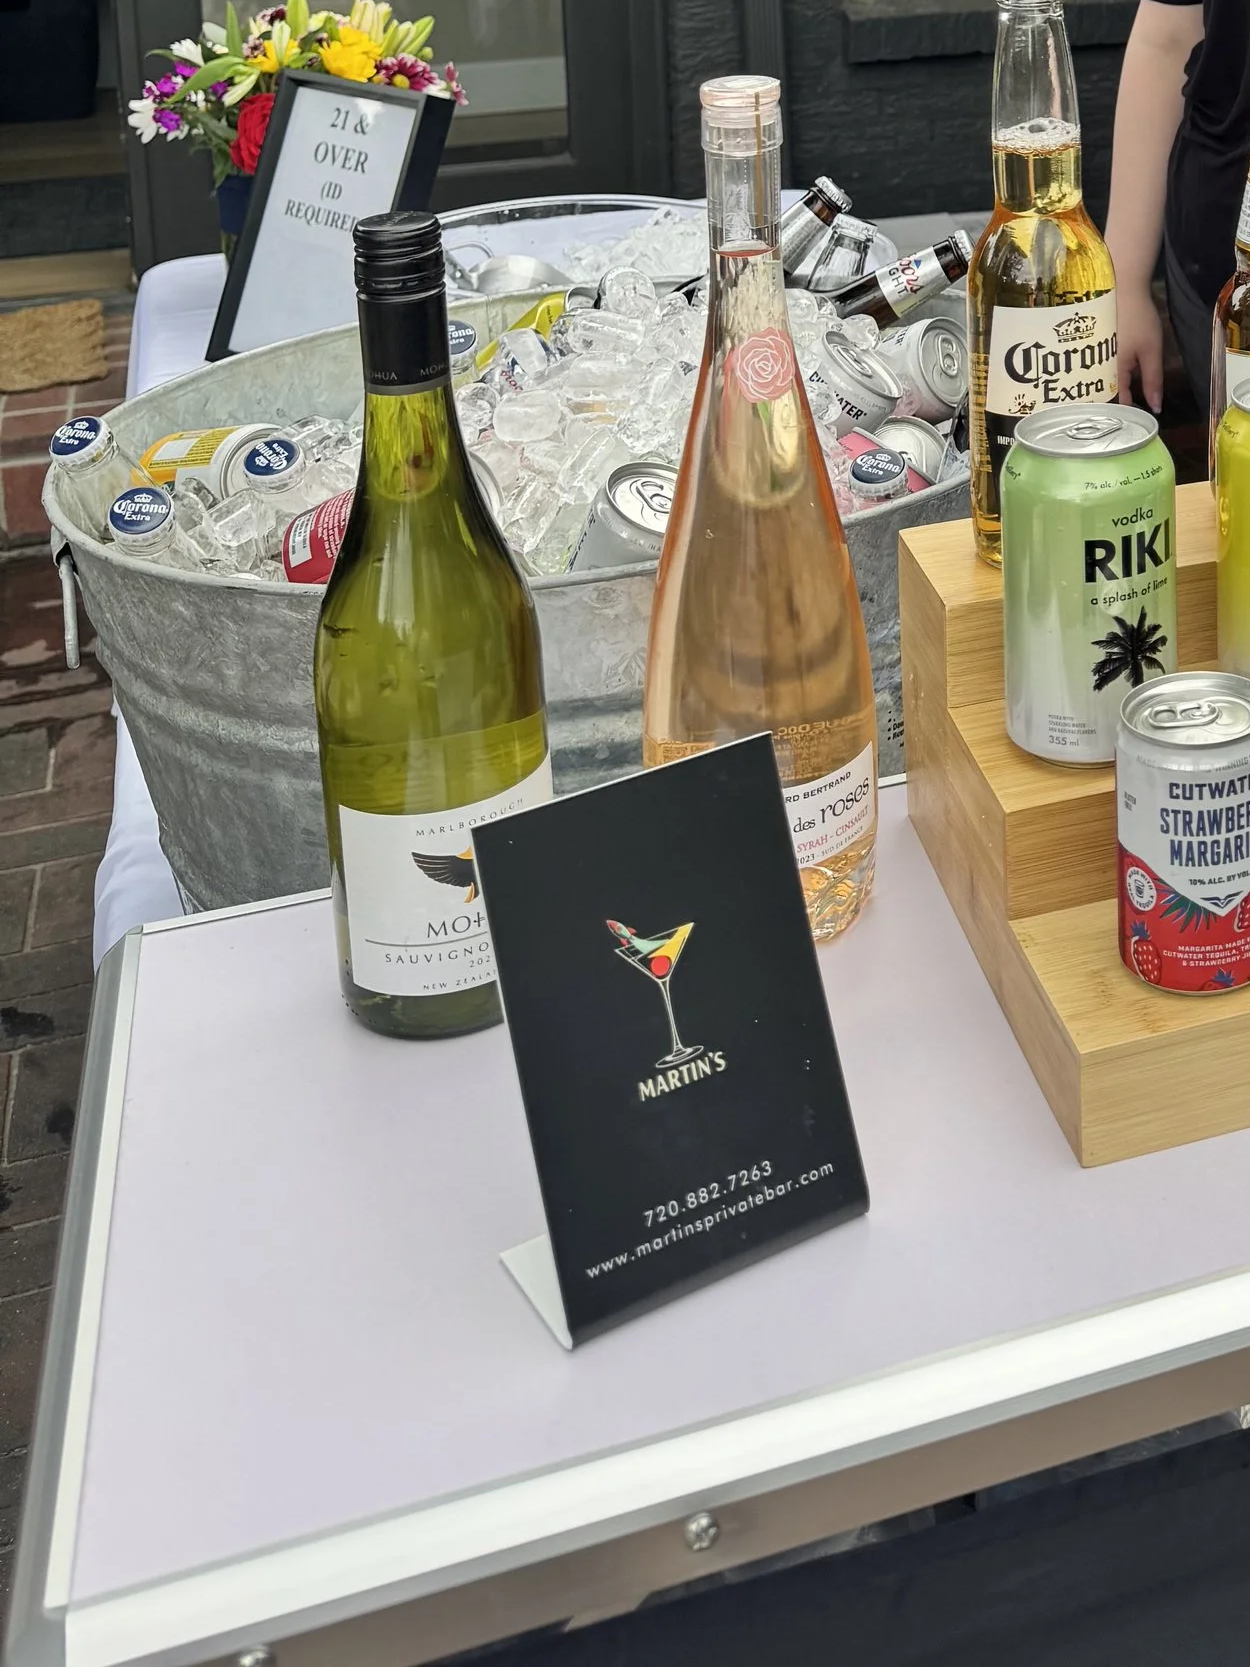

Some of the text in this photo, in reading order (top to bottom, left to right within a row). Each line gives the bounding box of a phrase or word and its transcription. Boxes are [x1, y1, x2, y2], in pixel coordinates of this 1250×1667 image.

[330, 107, 371, 135] 21 &
[314, 141, 369, 174] OVER
[320, 181, 342, 200] (ID
[1004, 331, 1118, 388] Corona
[809, 371, 865, 420] CATER
[1043, 377, 1105, 404] Extra
[55, 424, 96, 442] Corona
[856, 455, 901, 473] Corona
[113, 496, 168, 514] Corona
[124, 511, 151, 522] Extra
[1112, 507, 1154, 528] vodka
[1084, 517, 1170, 583] RIKI
[1090, 577, 1168, 607] a splash of lime
[803, 771, 852, 800] BERTRAND
[416, 798, 524, 836] MARLBOROUGH
[793, 777, 870, 833] des roses
[796, 835, 828, 854] SYRAH
[835, 805, 869, 837] CINSAULT
[1189, 878, 1206, 886] 10%
[1207, 876, 1225, 885] ALC.
[1226, 874, 1236, 883] BY
[385, 941, 490, 964] SAUVIGNO
[1162, 949, 1203, 960] CUTWATER
[1225, 939, 1246, 949] MADE
[469, 955, 491, 968] 202
[423, 969, 497, 991] NEW ZEALA
[638, 1051, 727, 1102] MARTIN'S
[644, 1160, 773, 1227] 720.882.7263
[586, 1162, 835, 1279] www.martinsprivatebar.com
